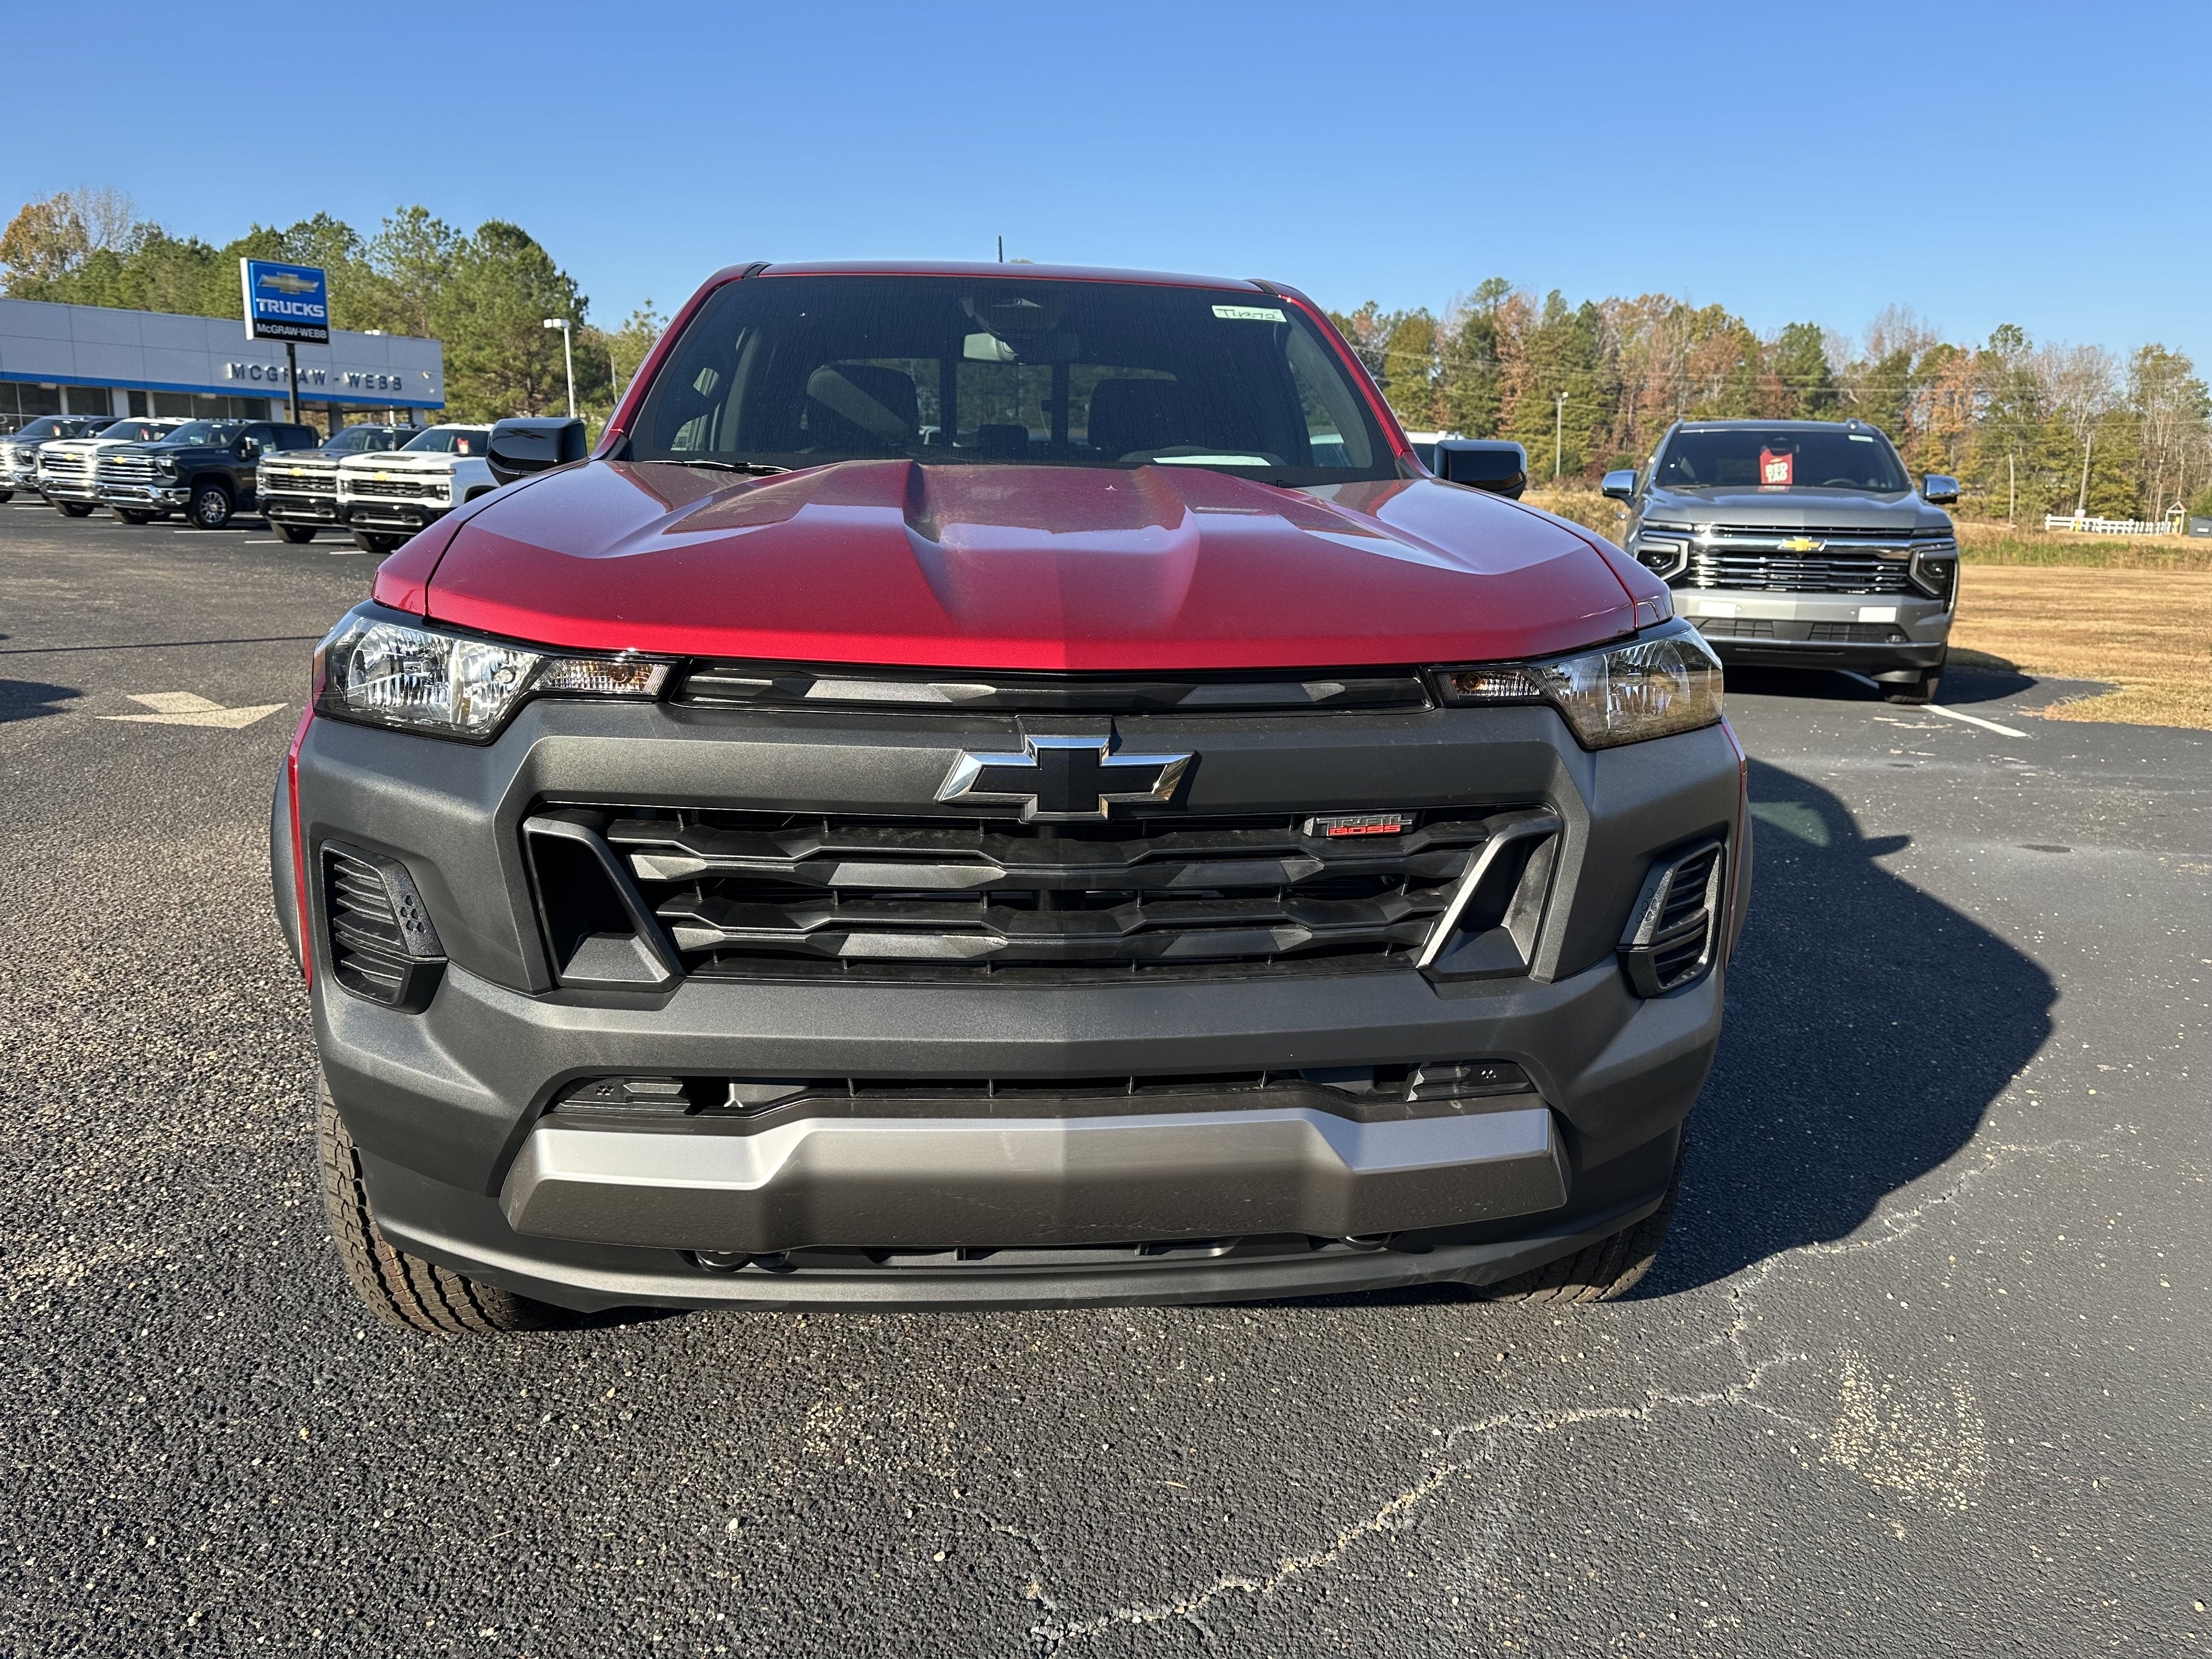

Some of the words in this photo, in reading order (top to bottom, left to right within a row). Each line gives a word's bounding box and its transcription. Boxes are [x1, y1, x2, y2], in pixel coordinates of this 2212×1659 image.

[256, 297, 325, 318] TRUCKS
[256, 323, 327, 339] McGRAW-WEBB
[344, 372, 402, 391] WEBB
[1328, 824, 1401, 836] BOSS
